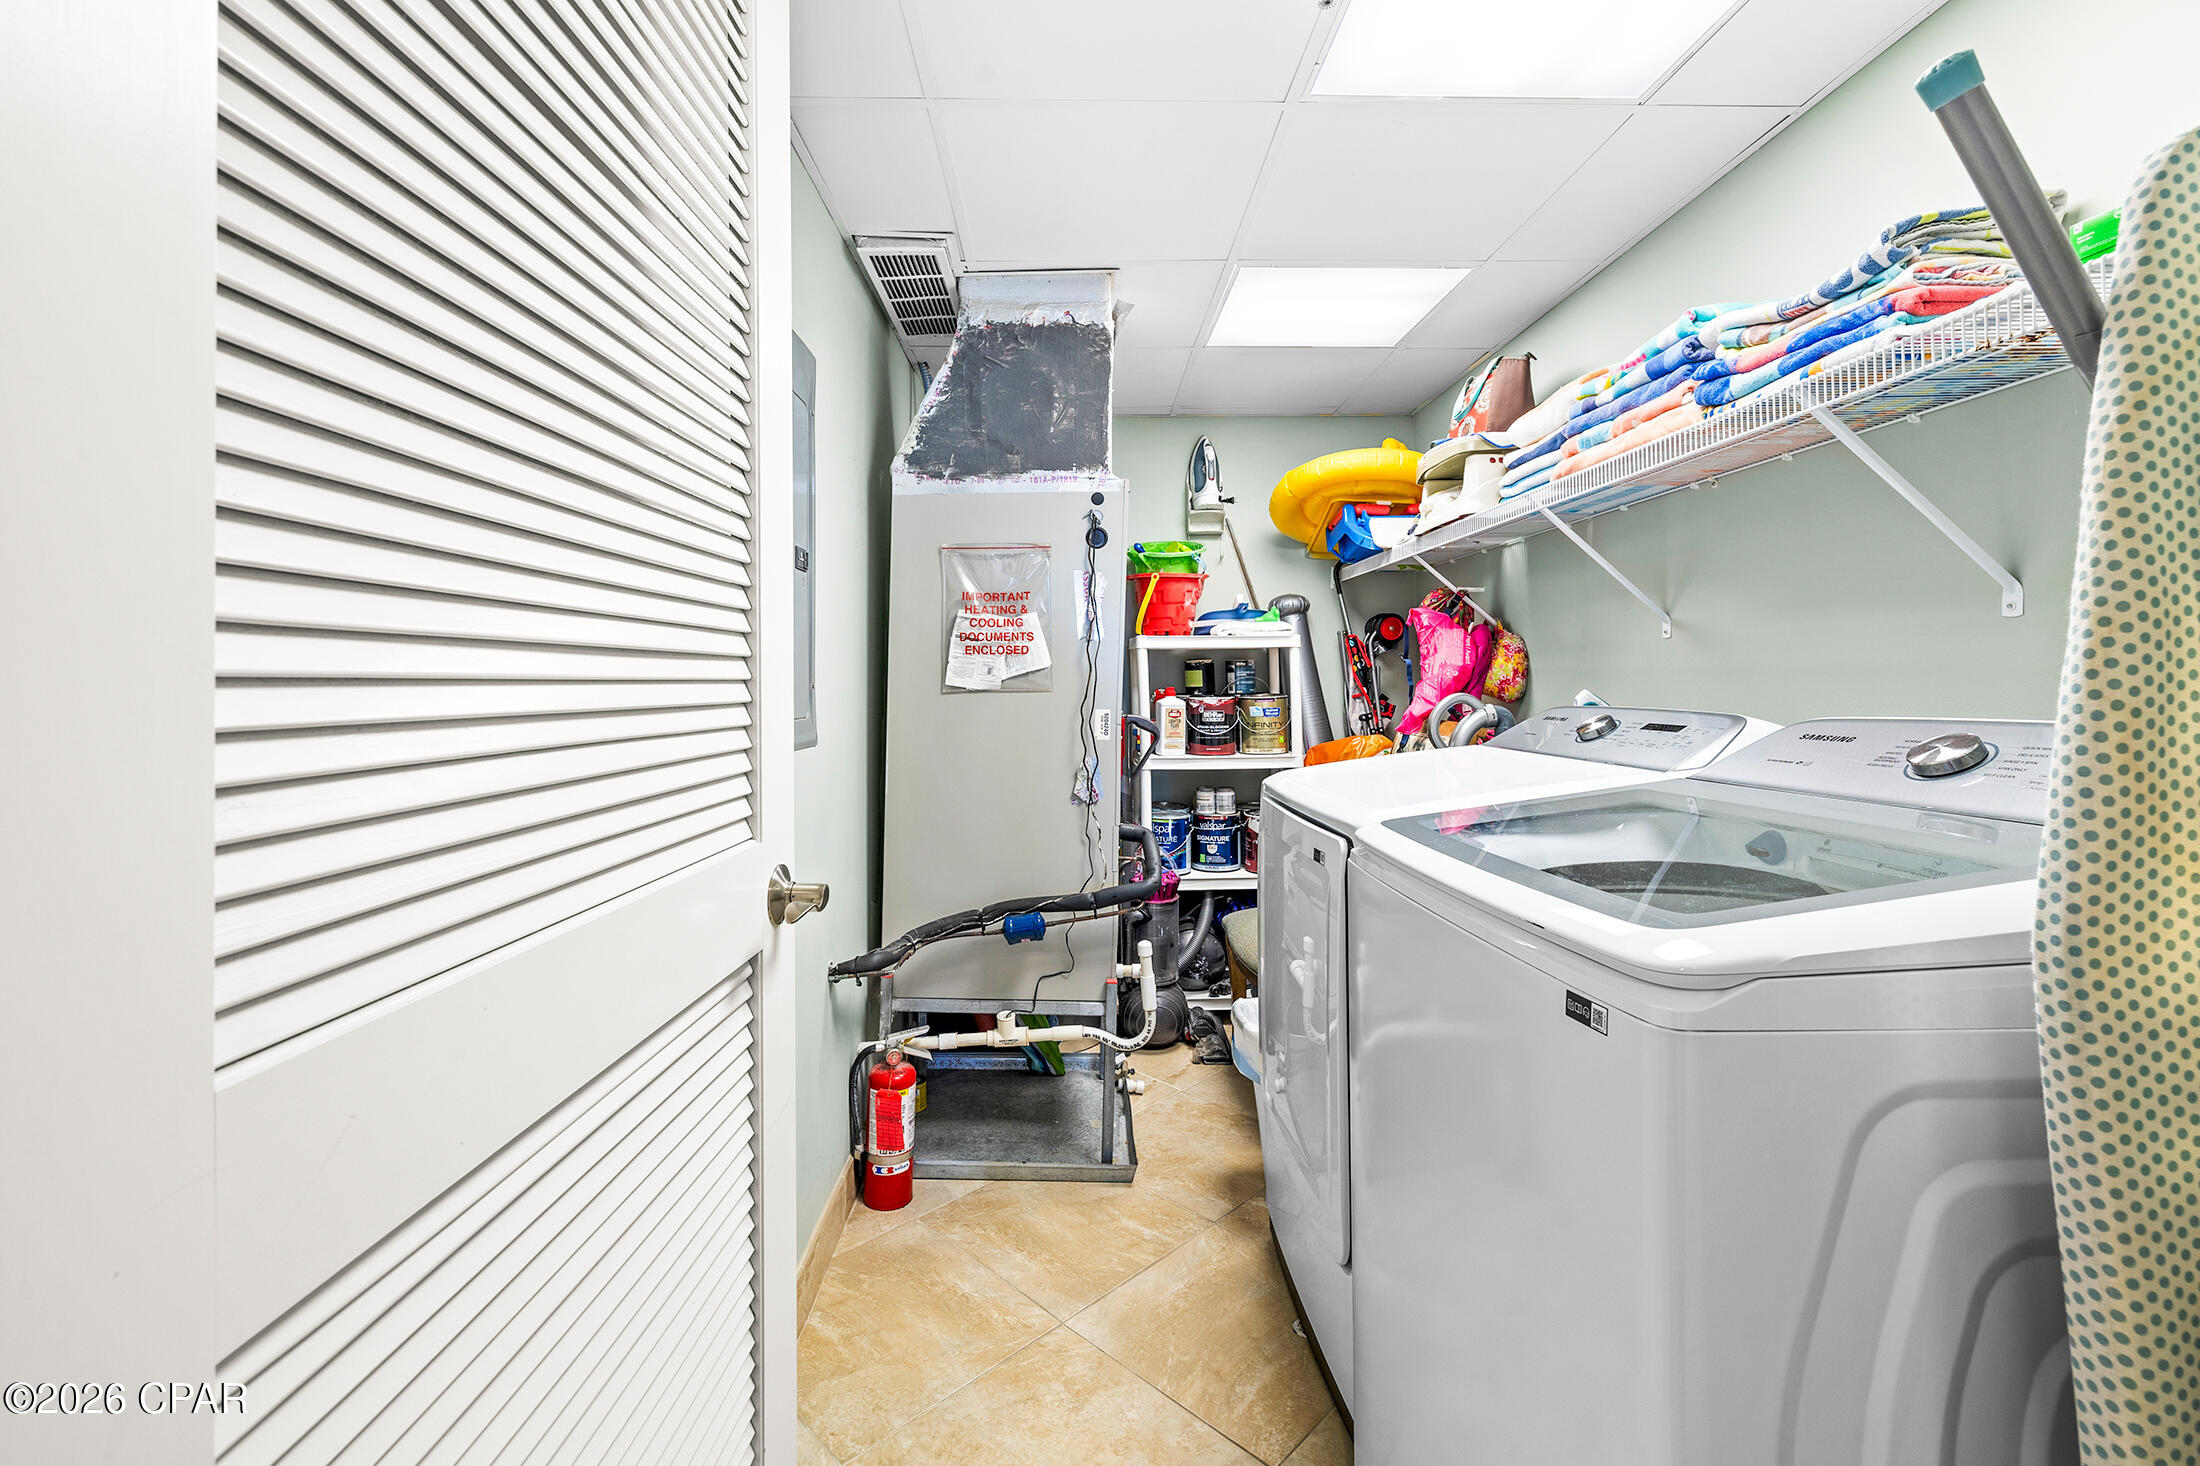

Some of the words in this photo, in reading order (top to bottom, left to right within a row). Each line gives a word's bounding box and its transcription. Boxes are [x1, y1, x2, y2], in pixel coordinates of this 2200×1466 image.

[961, 591, 1031, 602] IMPORTANT
[964, 604, 1017, 615] HEATING
[1020, 604, 1028, 614] &
[969, 617, 1024, 628] COOLING
[959, 631, 1035, 642] DOCUMENTS
[964, 645, 1030, 655] ENCLOSED
[1799, 733, 1857, 743] SAMSUNG
[1152, 823, 1174, 834] lspar
